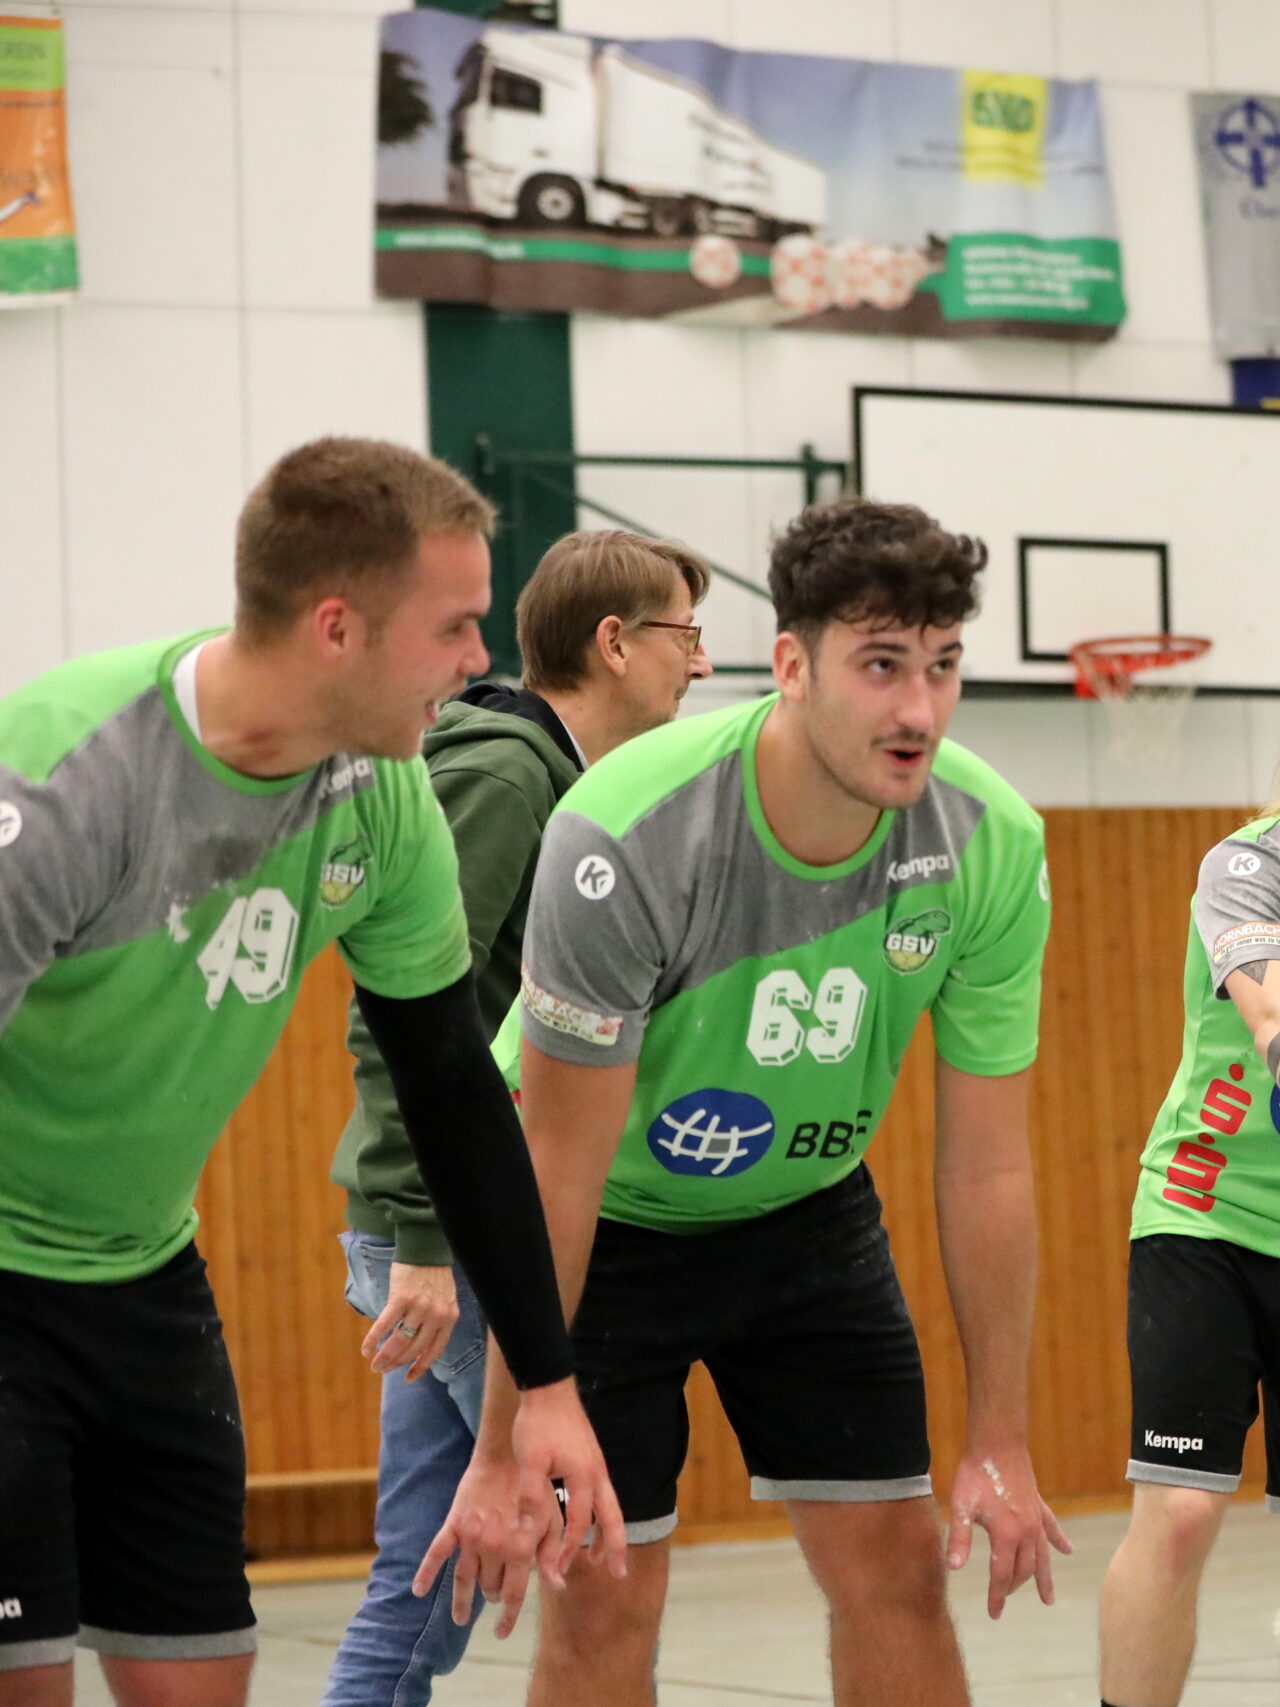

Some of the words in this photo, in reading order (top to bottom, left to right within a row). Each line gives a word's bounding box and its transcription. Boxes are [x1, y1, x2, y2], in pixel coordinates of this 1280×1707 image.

[885, 933, 936, 956] GSV
[746, 966, 868, 1067] 69
[1144, 1429, 1204, 1454] Kempa
